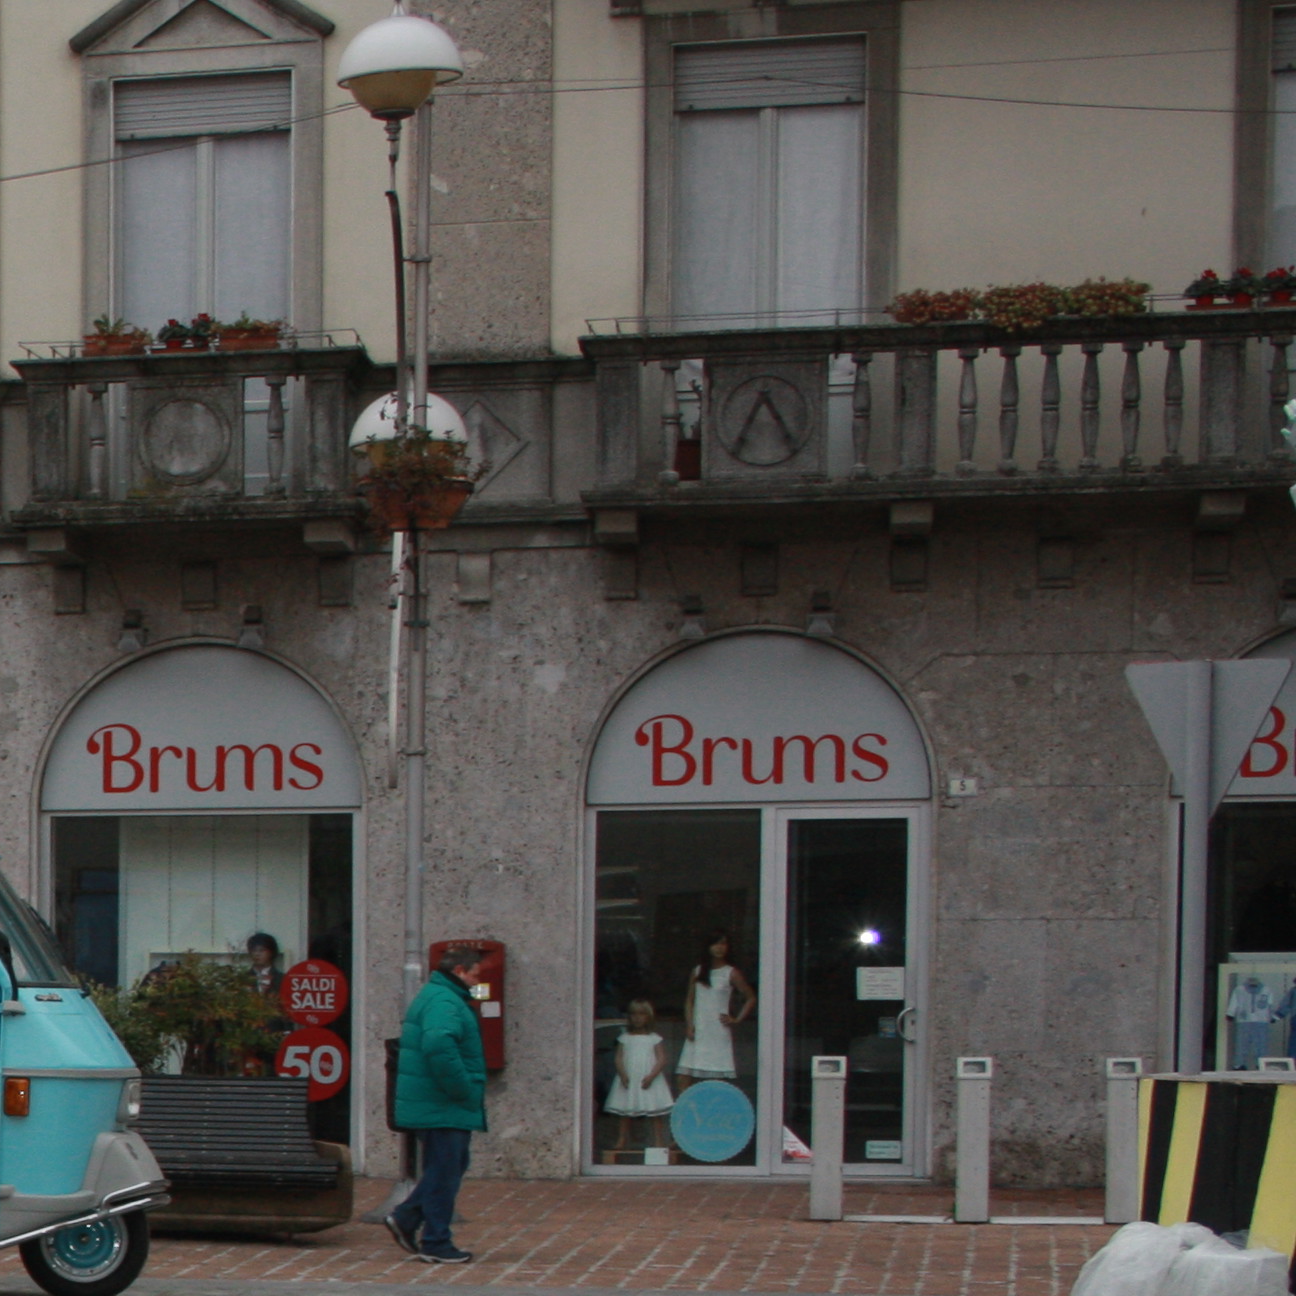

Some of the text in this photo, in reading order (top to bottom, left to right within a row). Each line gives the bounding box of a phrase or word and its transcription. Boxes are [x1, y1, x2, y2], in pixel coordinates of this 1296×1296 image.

[86, 723, 323, 793] Brums
[634, 713, 889, 787] Brums
[291, 978, 335, 991] SALDI
[291, 992, 335, 1010] SALE
